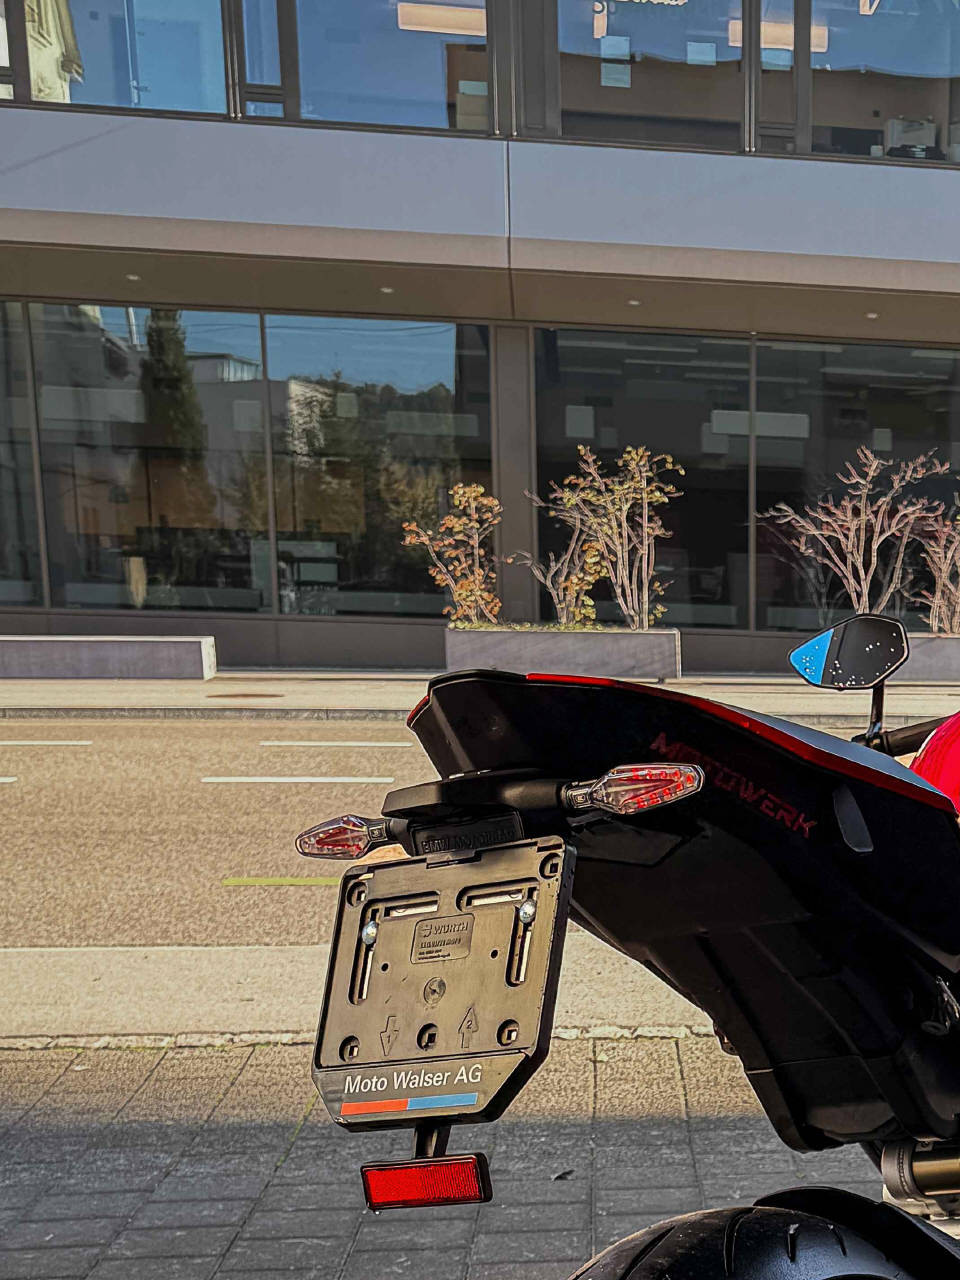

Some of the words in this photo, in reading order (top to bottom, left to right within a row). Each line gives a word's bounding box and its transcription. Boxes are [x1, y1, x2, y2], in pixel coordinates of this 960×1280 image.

[344, 1074, 388, 1094] Moto
[393, 1069, 451, 1090] Walser
[453, 1063, 482, 1085] AG
